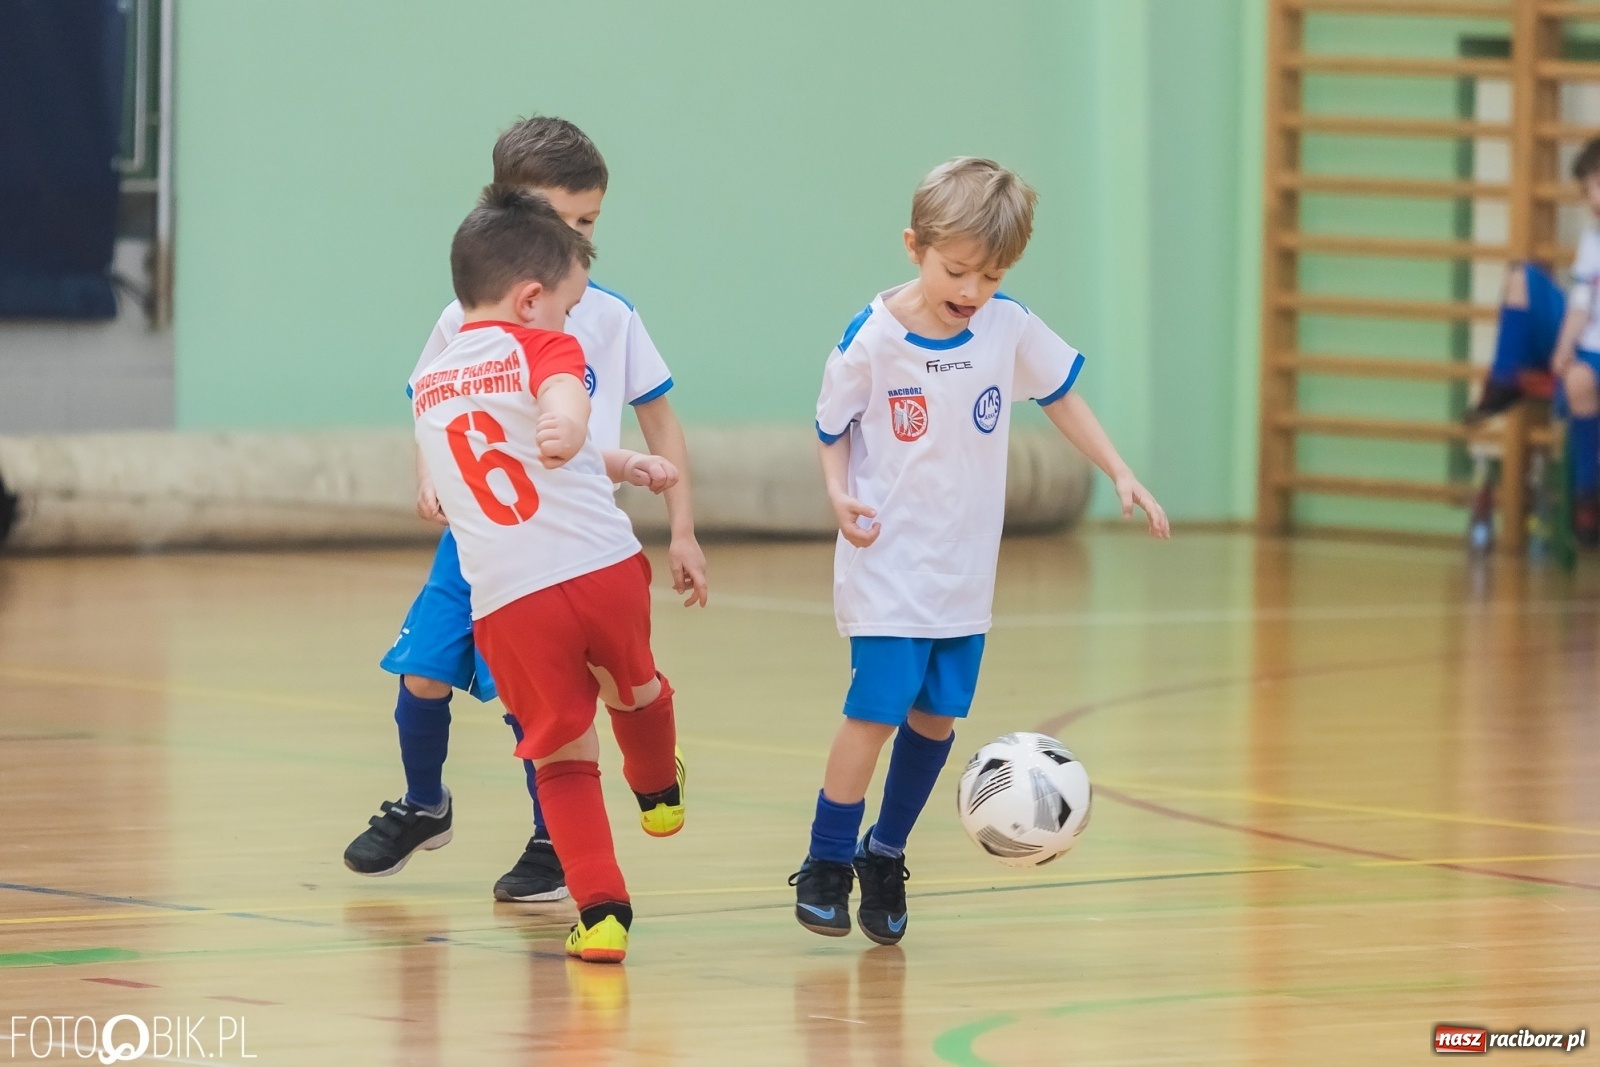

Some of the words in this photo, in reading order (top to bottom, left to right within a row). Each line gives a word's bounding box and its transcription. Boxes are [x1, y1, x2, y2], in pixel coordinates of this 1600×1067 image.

[461, 372, 522, 396] RYBNIK
[977, 390, 999, 418] UKS
[445, 410, 540, 527] 6
